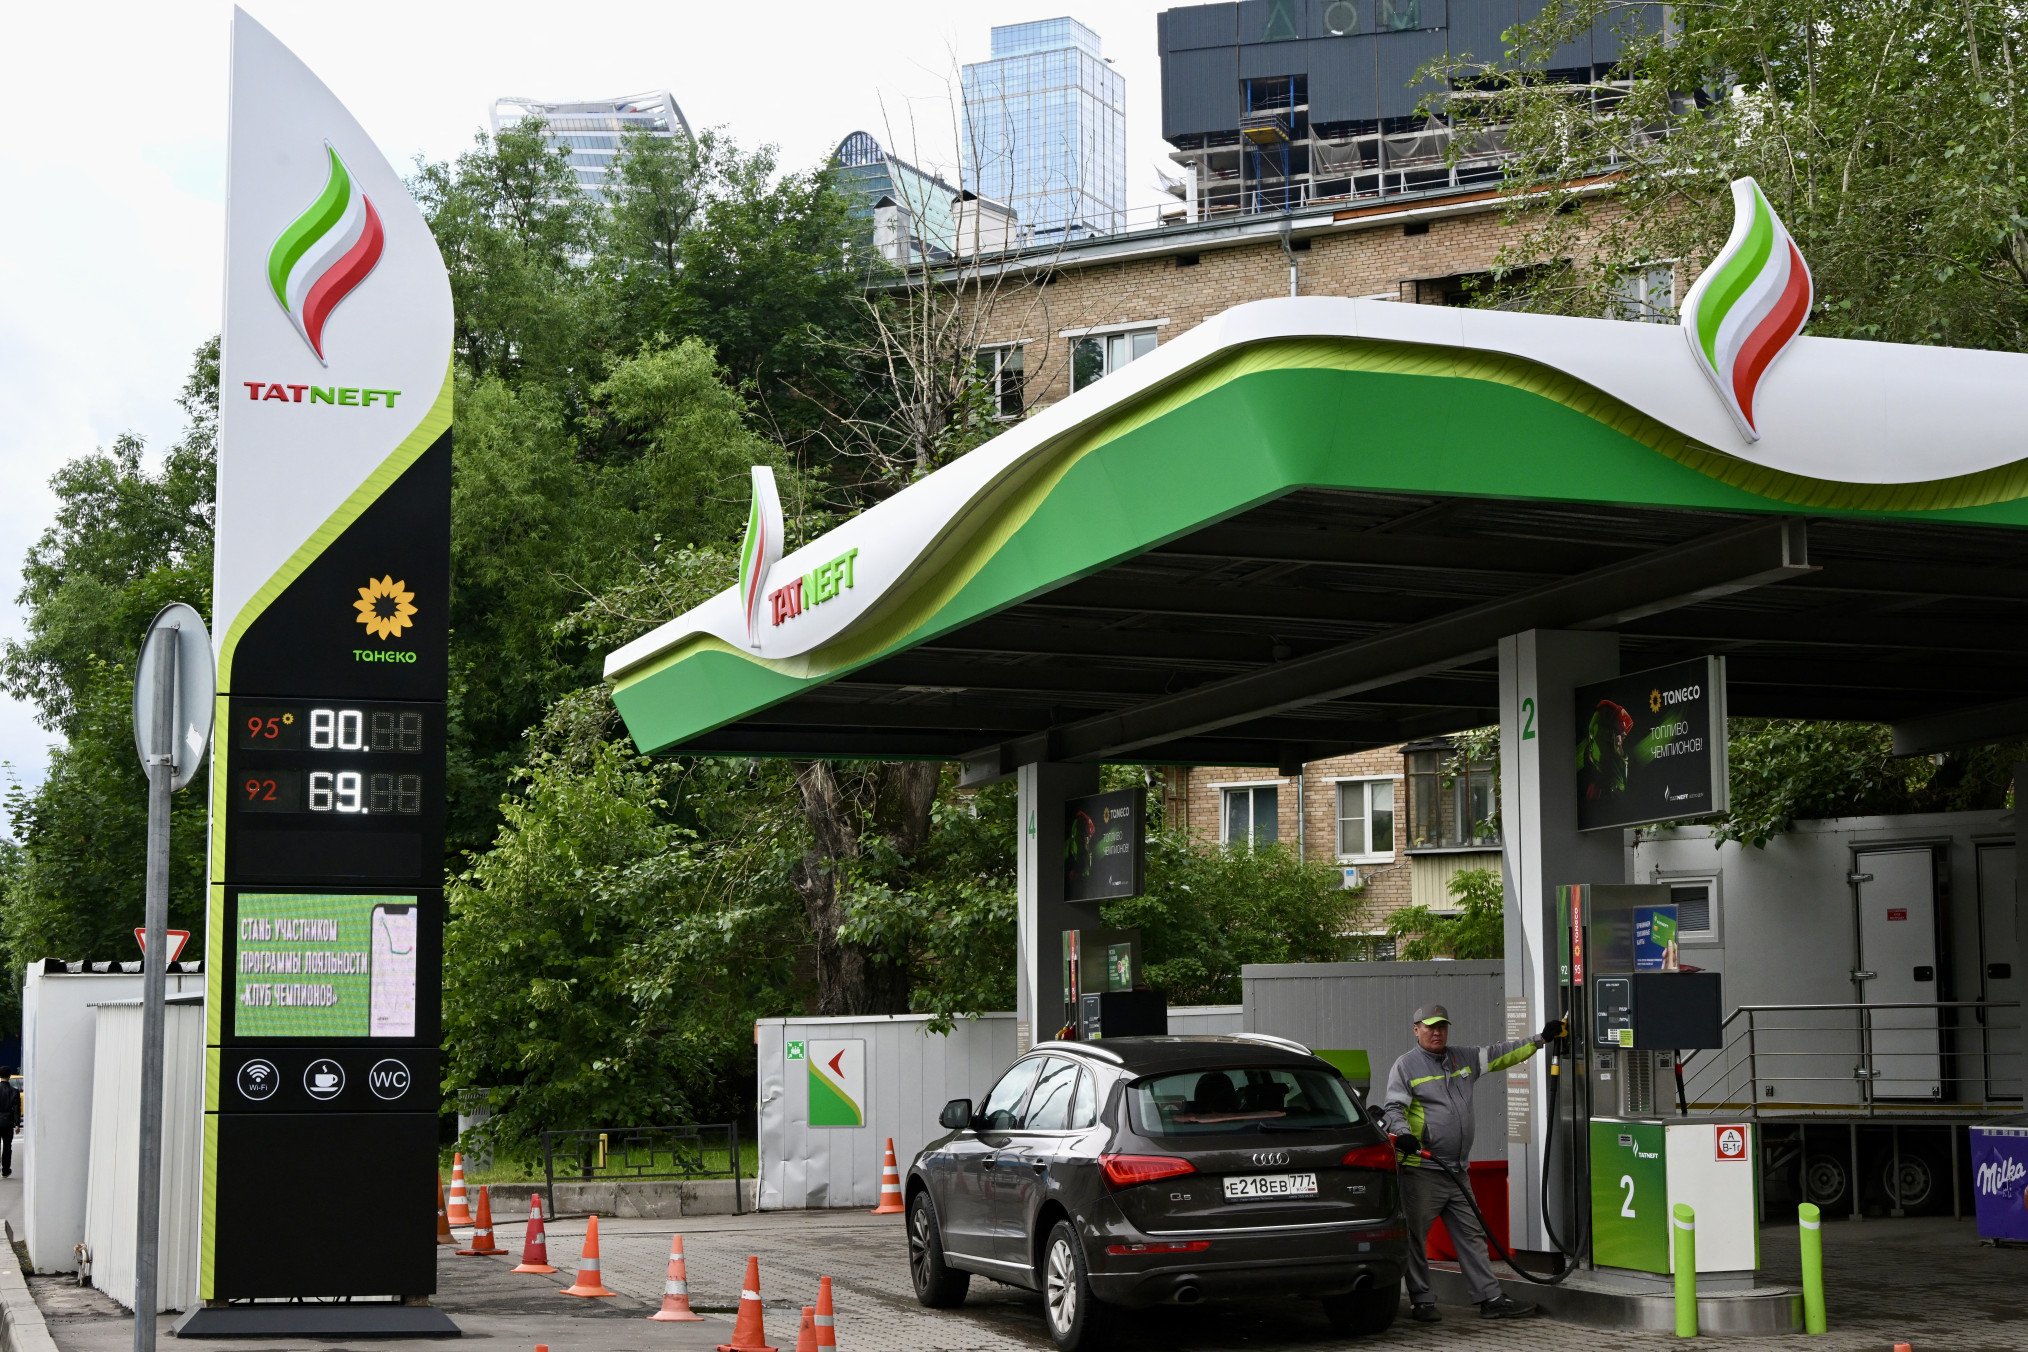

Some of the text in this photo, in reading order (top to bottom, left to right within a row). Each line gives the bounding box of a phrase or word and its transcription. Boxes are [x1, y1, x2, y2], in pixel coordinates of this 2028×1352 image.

[243, 382, 401, 408] TATNEFT
[768, 547, 858, 626] TATNEFT
[247, 716, 281, 739] 95
[1522, 697, 1535, 740] 2
[1650, 720, 1689, 741] ТОПЛИВО
[1651, 737, 1703, 760] ЧЕМПИОНОВ!
[245, 779, 277, 801] 92
[1028, 809, 1037, 840] 4
[241, 918, 338, 942] СТАНЬ УЧАСТНИКОМ
[240, 951, 369, 975] ПРОГРАММЫ ЛОЯЛЬНОСТИ
[1560, 965, 1568, 975] 92
[1574, 964, 1581, 974] 95
[240, 983, 338, 1007] «КЛУБ ЧЕМПИОНОВ»
[373, 1071, 407, 1088] WC
[1290, 1174, 1312, 1188] 777
[1977, 1156, 2027, 1196] Milka
[1170, 1192, 1191, 1201] Q5
[1620, 1174, 1635, 1219] 2
